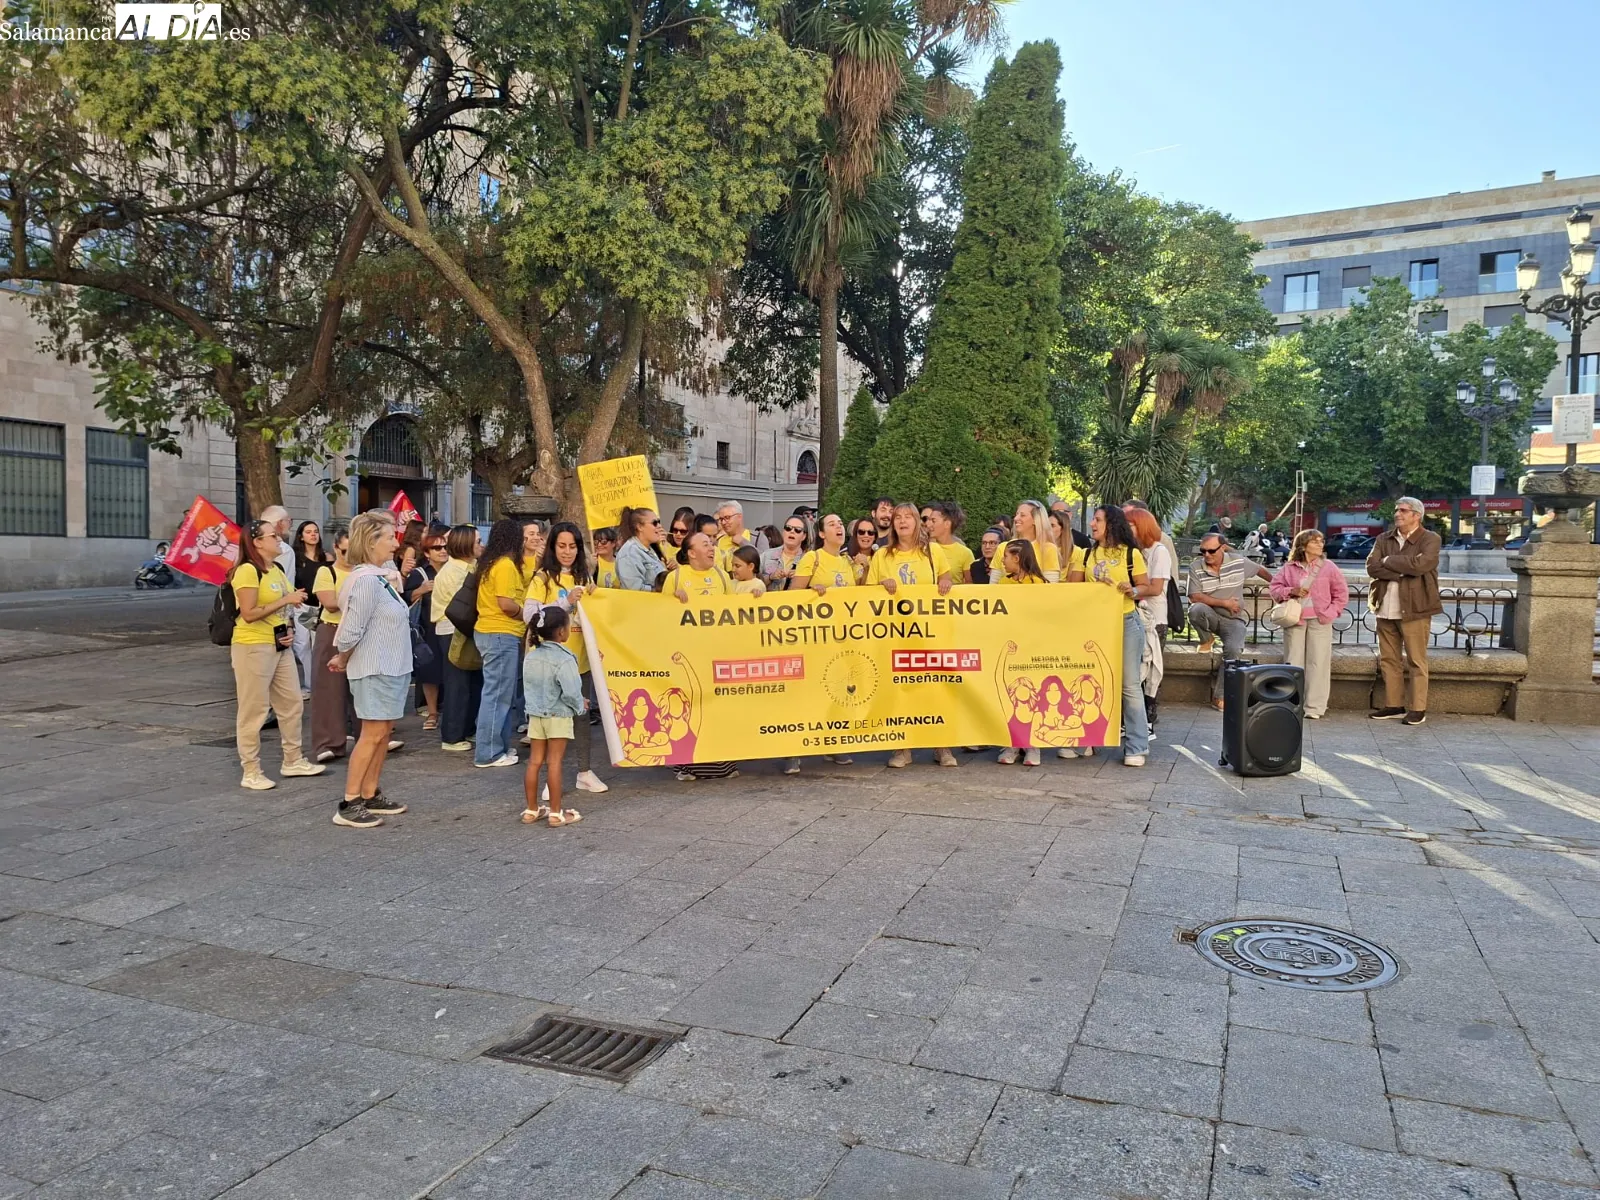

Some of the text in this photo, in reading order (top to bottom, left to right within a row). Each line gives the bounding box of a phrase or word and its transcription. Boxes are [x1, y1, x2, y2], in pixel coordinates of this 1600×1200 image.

[680, 599, 1008, 627] ABANDONO Y VIOLENCIA
[760, 622, 935, 647] INSTITUCIONAL
[894, 653, 957, 668] CCOO
[608, 670, 671, 678] MENOS RATIOS
[715, 661, 779, 679] CCOO
[893, 672, 963, 683] enseñanza
[714, 683, 785, 696] enseñanza
[759, 716, 945, 735] SOMOS LA VOZ DE LA INFANCIA
[802, 730, 905, 746] 0-3 ES EDUCACIÓN
